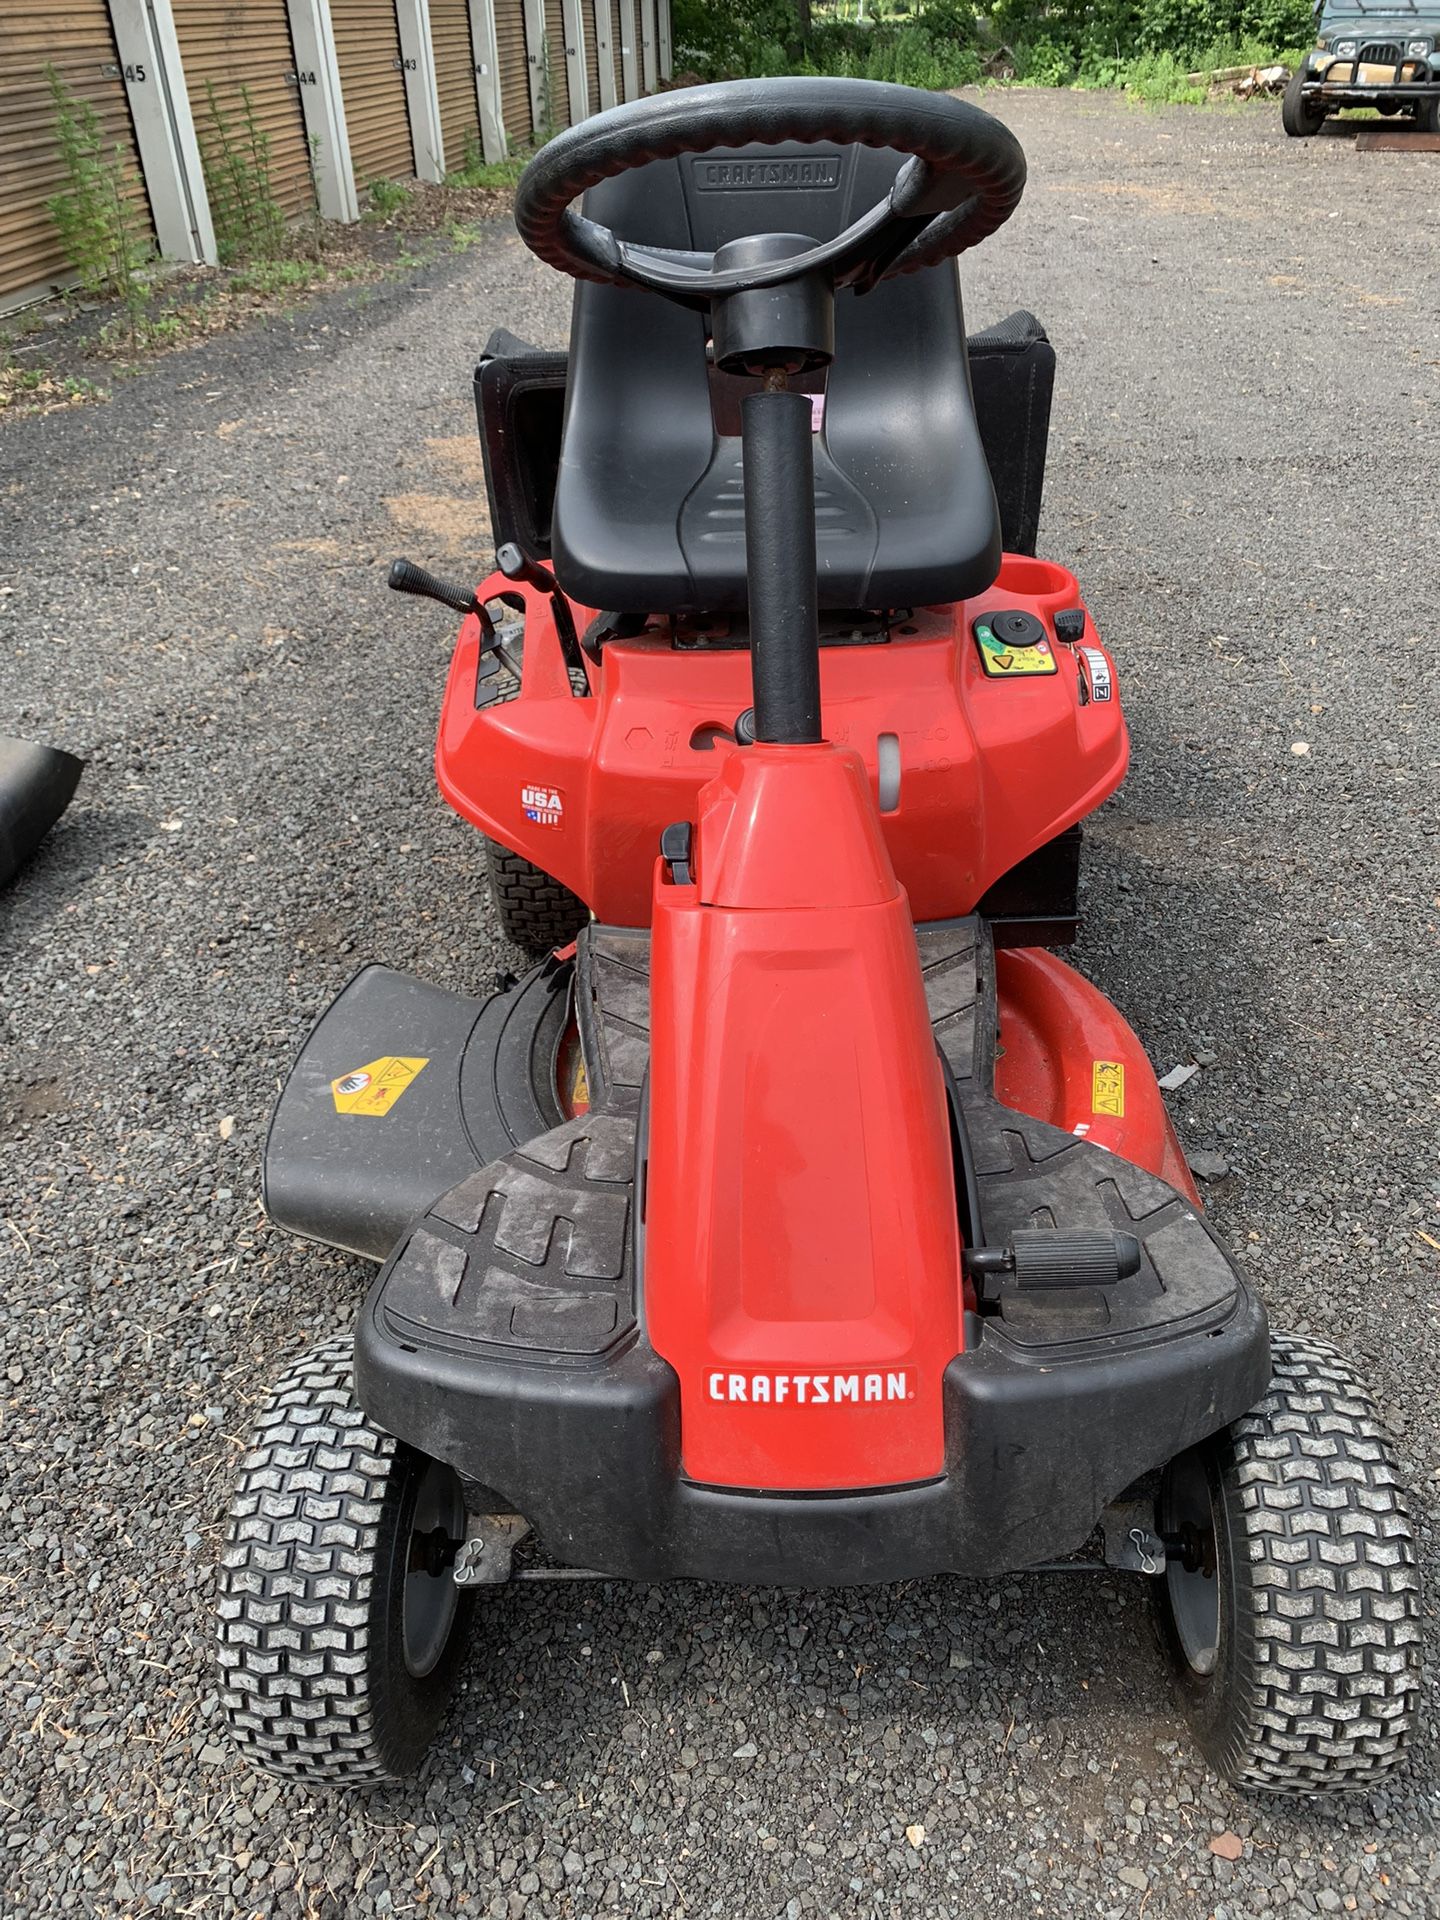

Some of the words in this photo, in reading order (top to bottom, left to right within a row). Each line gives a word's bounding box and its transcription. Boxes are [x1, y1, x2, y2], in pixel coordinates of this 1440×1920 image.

[125, 64, 146, 82] 45
[404, 58, 417, 71] 43
[300, 71, 317, 85] 44
[522, 788, 563, 810] USA
[709, 1373, 907, 1403] CRAFTSMAN
